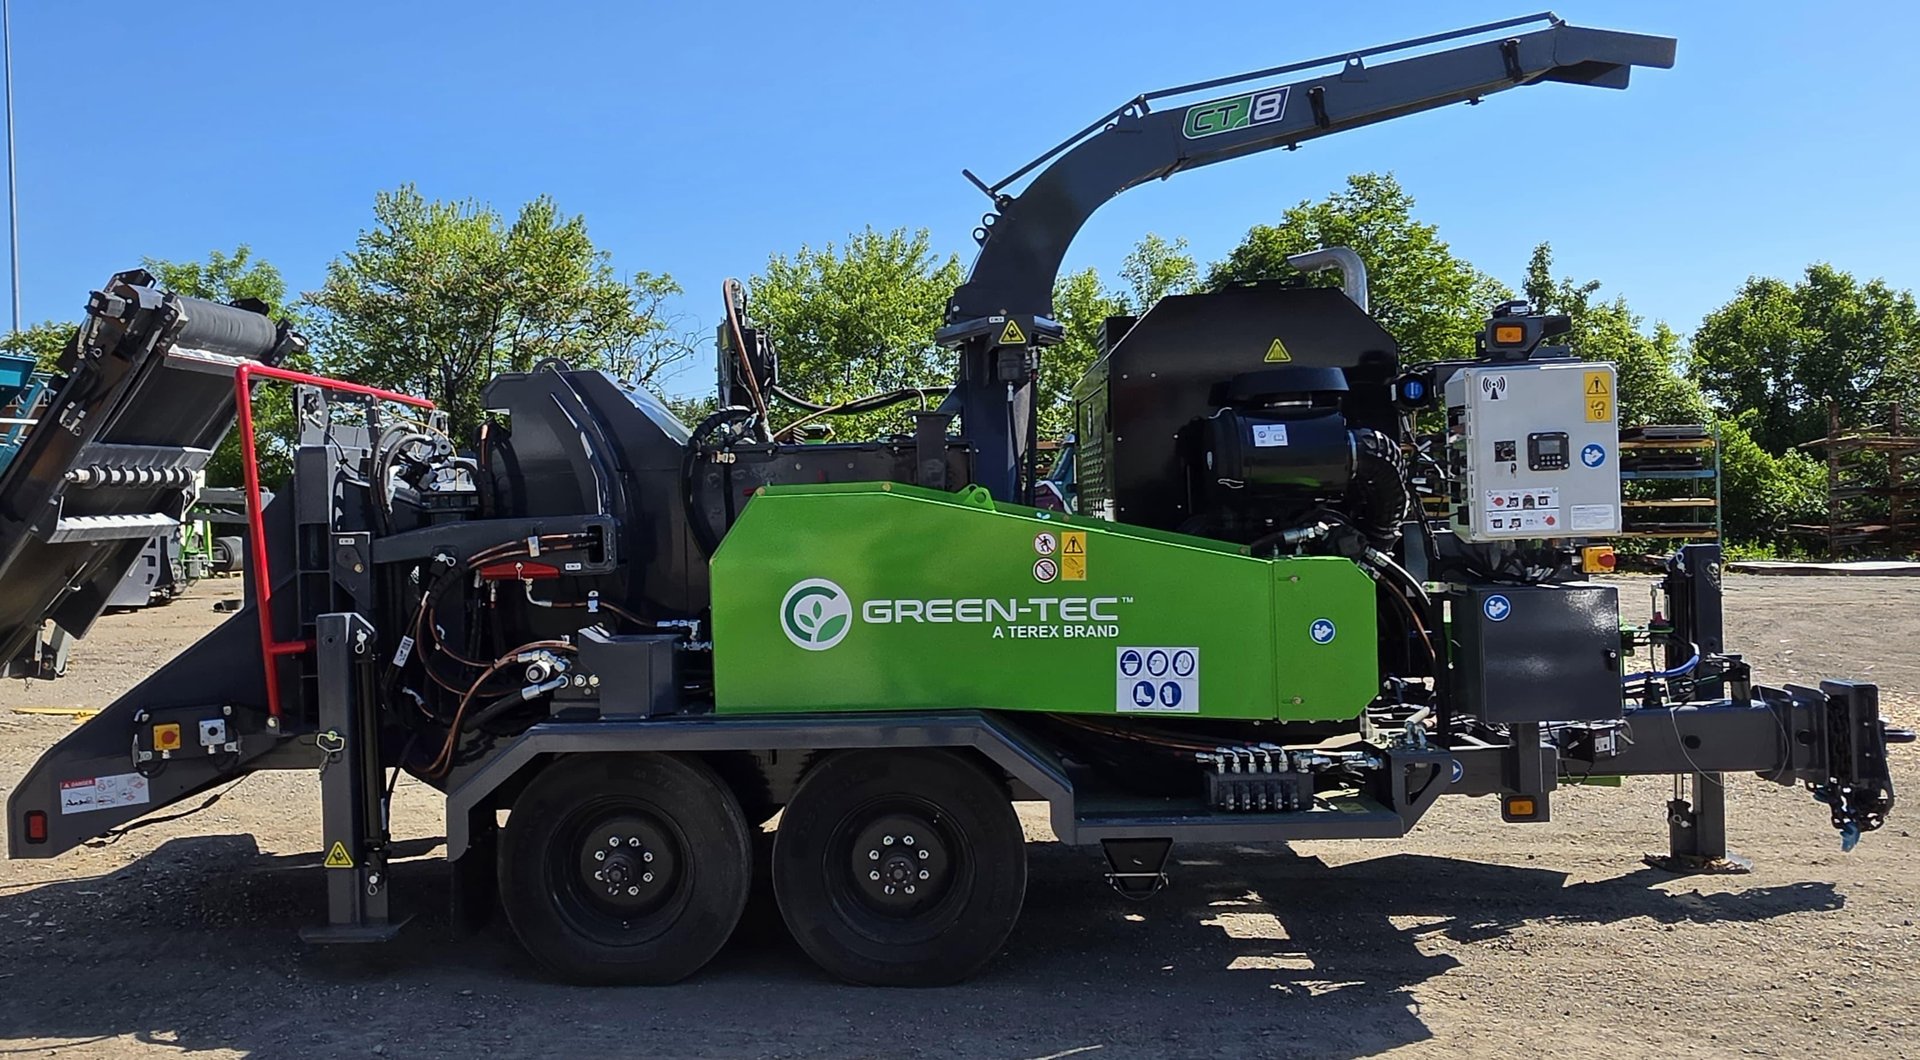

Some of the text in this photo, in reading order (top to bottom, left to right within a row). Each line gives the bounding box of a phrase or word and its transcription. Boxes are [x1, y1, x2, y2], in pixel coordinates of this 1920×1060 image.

[1193, 94, 1281, 132] CT 8
[863, 598, 1118, 623] GREEN-TEC
[992, 625, 1119, 638] A TEREX BRAND
